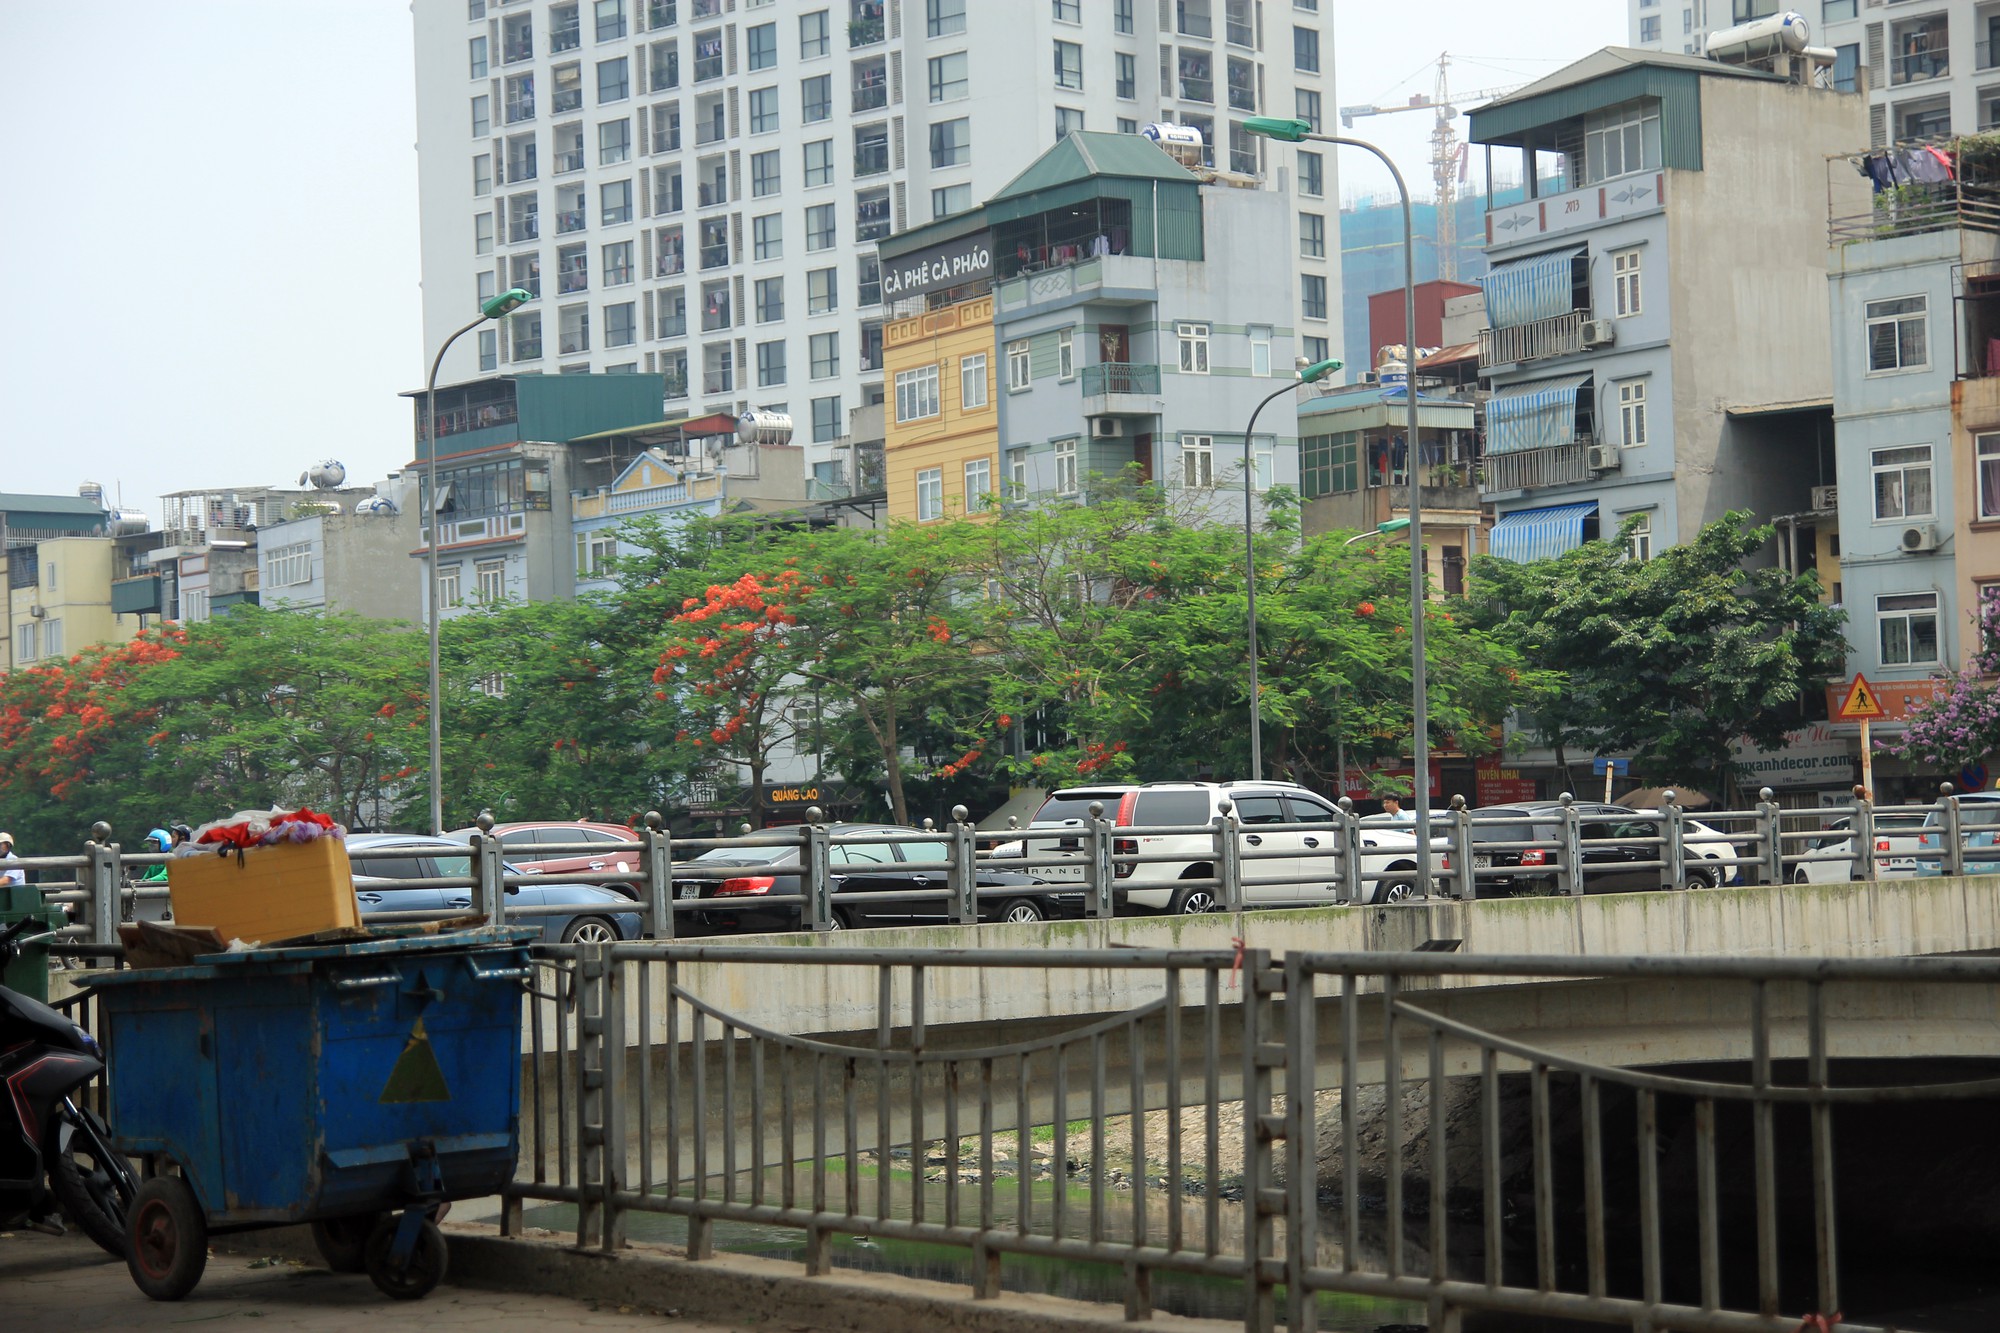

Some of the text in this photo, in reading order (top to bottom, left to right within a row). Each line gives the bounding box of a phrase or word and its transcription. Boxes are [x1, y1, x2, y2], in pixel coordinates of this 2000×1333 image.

[884, 244, 989, 294] CÀ PHÊ CÀ PHÁO
[772, 785, 800, 802] QUẢNG
[1031, 867, 1081, 875] RANG
[684, 885, 696, 895] 29A
